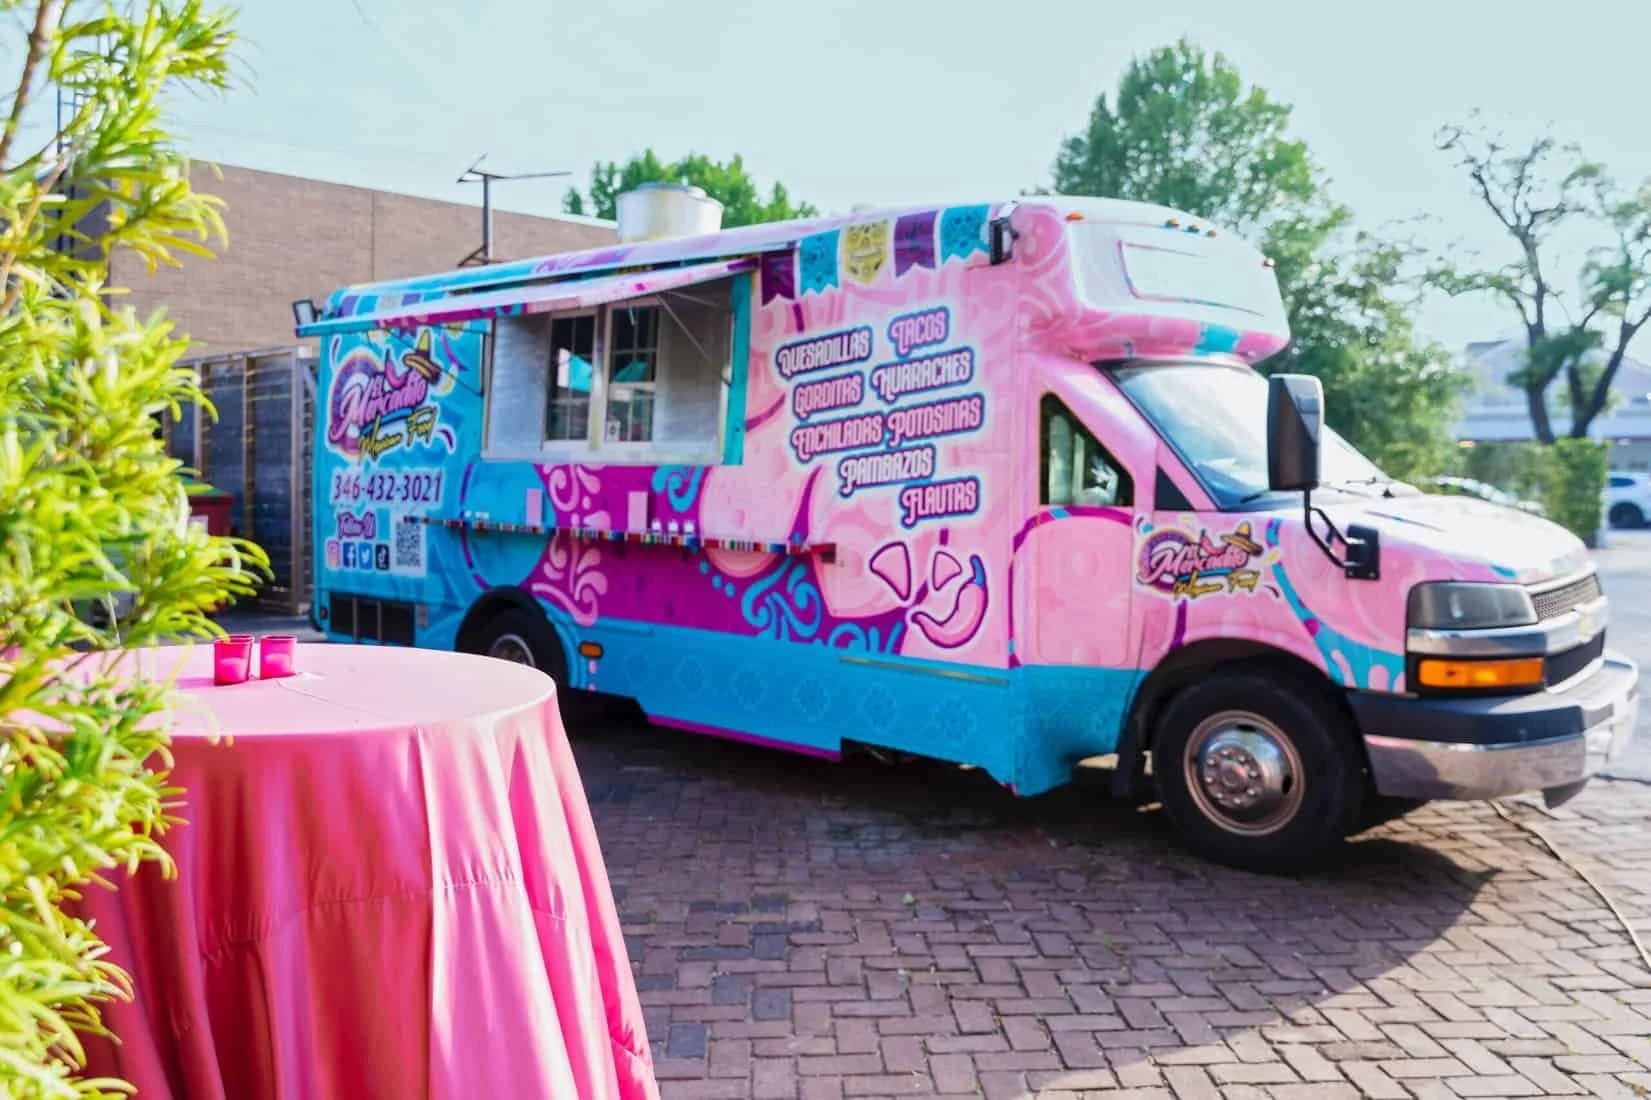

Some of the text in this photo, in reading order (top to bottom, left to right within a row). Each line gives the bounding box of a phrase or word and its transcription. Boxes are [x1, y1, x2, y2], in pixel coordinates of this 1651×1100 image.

[777, 329, 871, 378] QUESADILLAS
[889, 310, 947, 356] TACOS
[794, 375, 863, 418] GORDITAS
[872, 350, 972, 402] HUARACHES
[791, 397, 983, 461] ENCHILADAS POTOSINAS
[332, 470, 443, 503] 346-432-3021
[840, 447, 934, 496] PAMBAZOS
[900, 480, 978, 526] FLAUTAS
